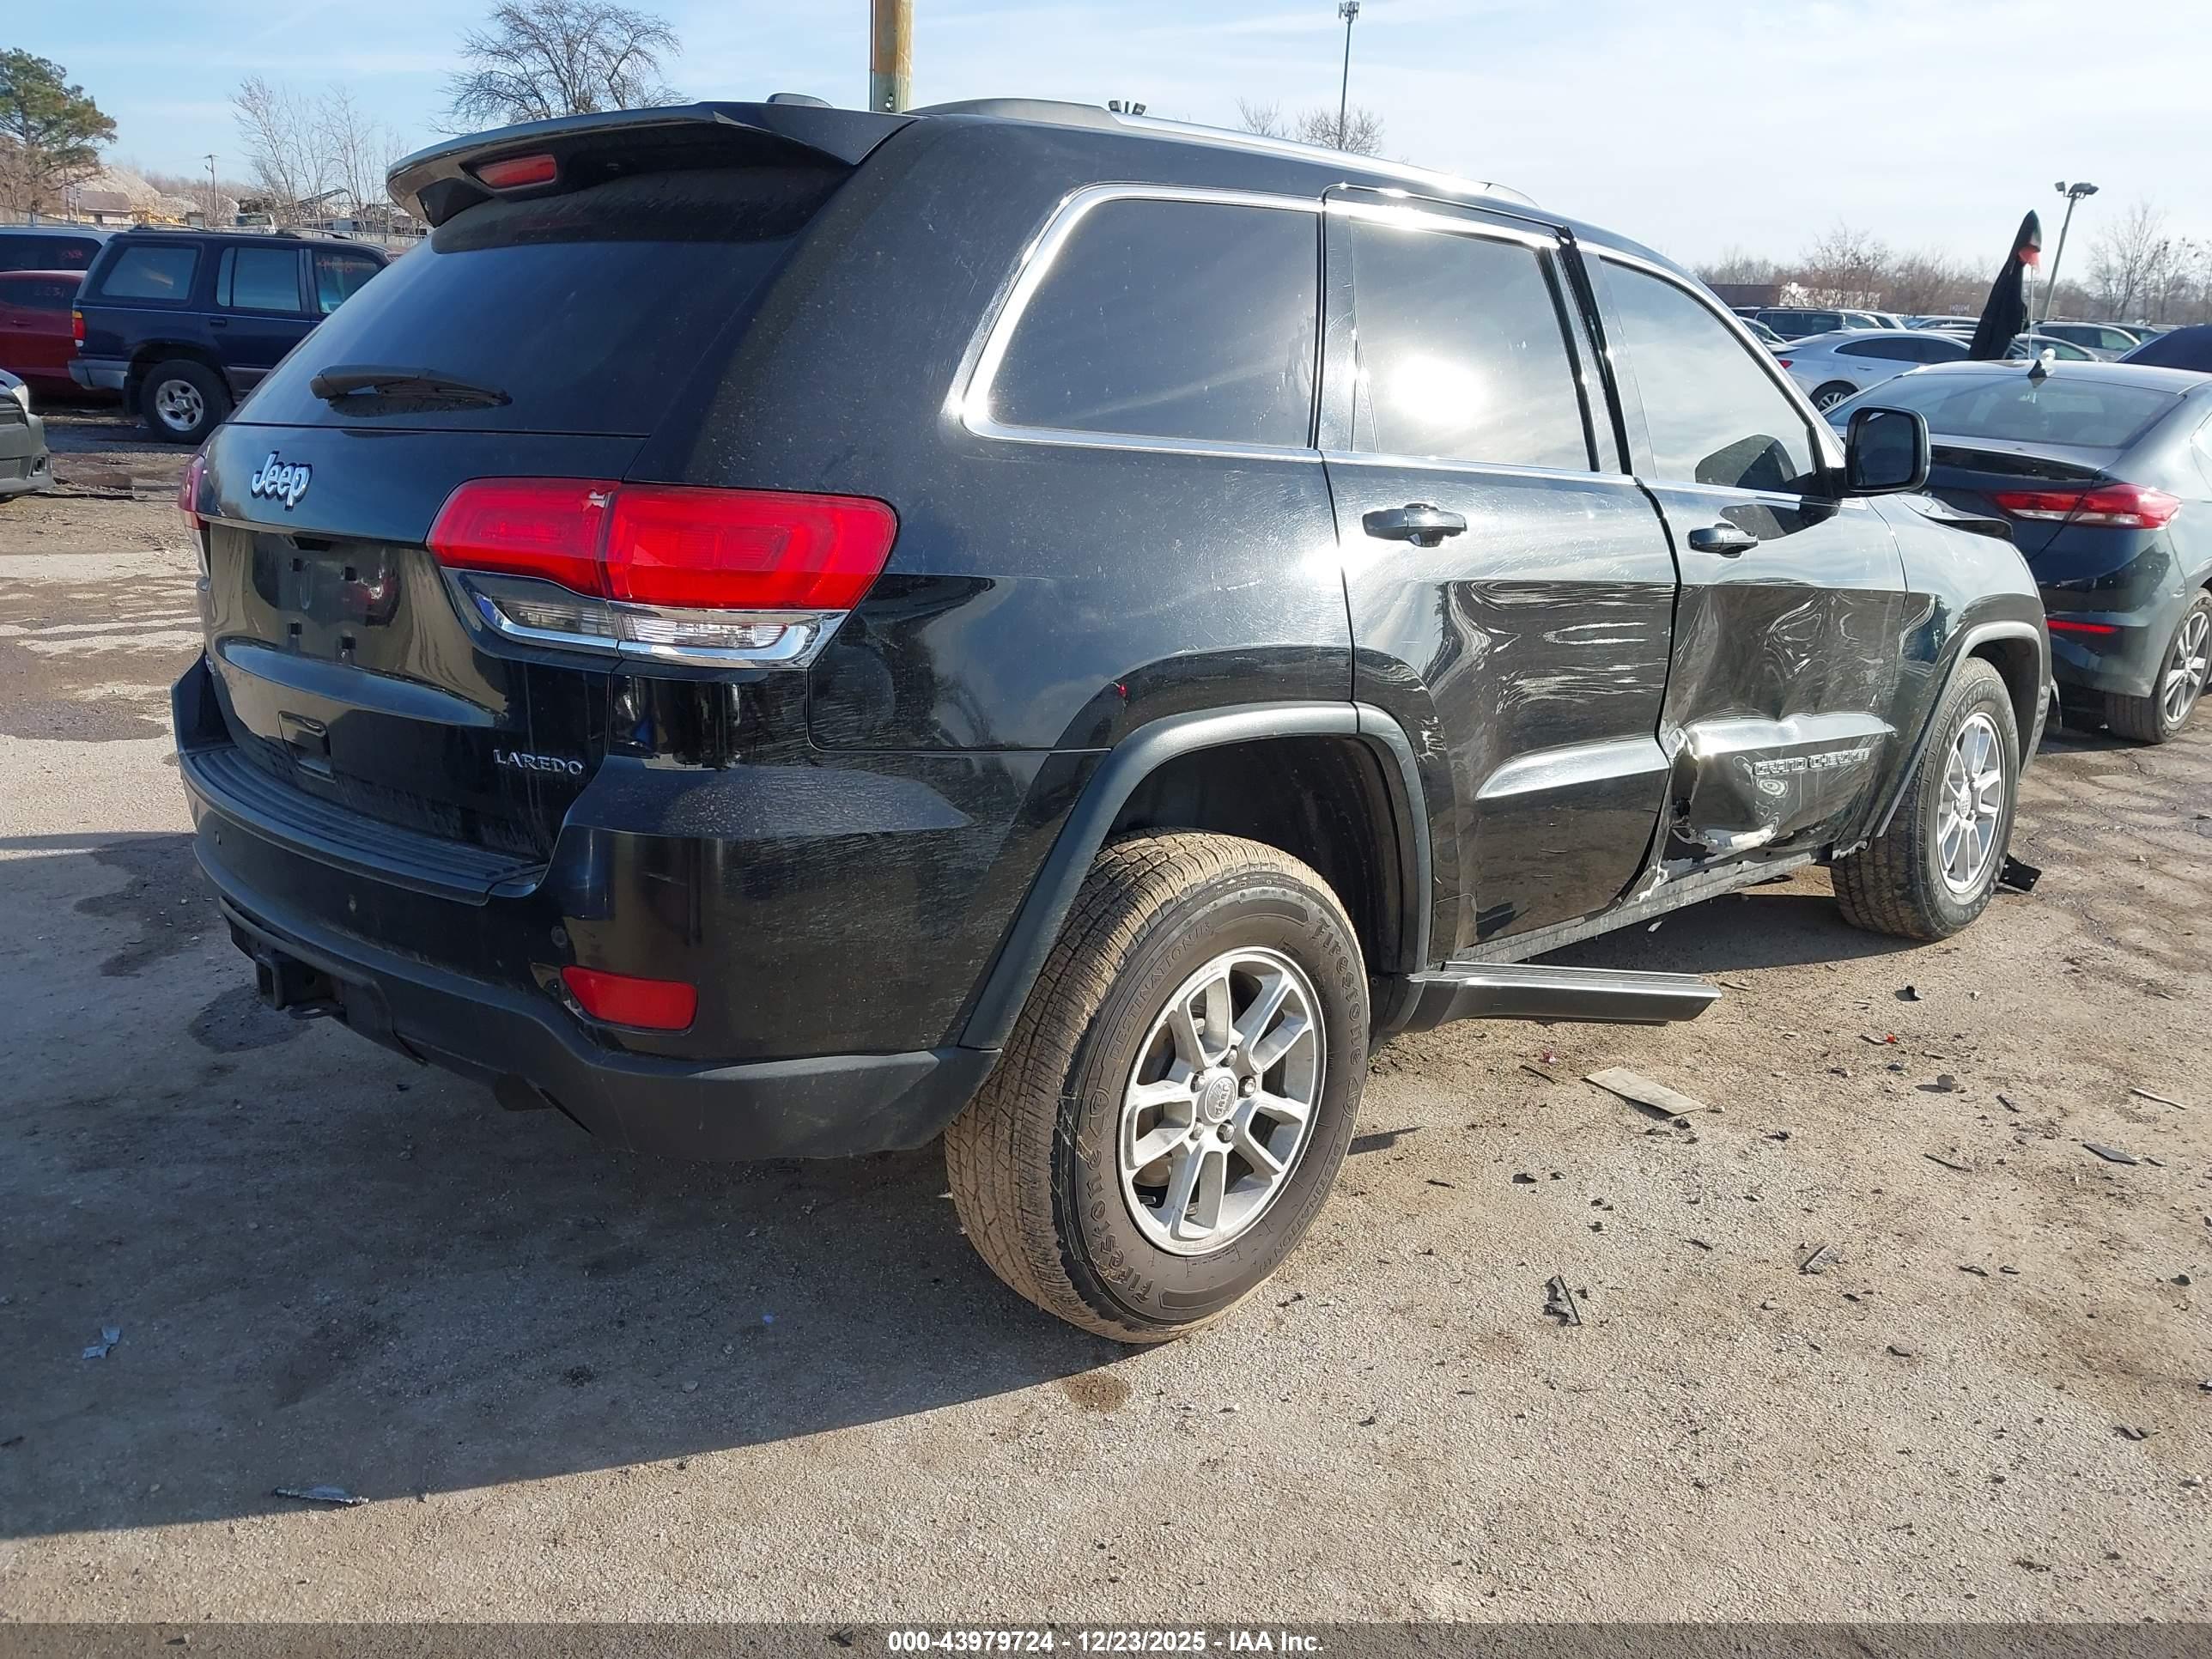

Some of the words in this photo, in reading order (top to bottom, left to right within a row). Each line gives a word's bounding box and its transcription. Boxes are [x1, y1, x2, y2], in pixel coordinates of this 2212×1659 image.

[251, 451, 312, 510] Jeep
[494, 749, 584, 775] LAREDO
[1753, 757, 1808, 775] GRAND
[1808, 747, 1871, 769] CHEROKEE
